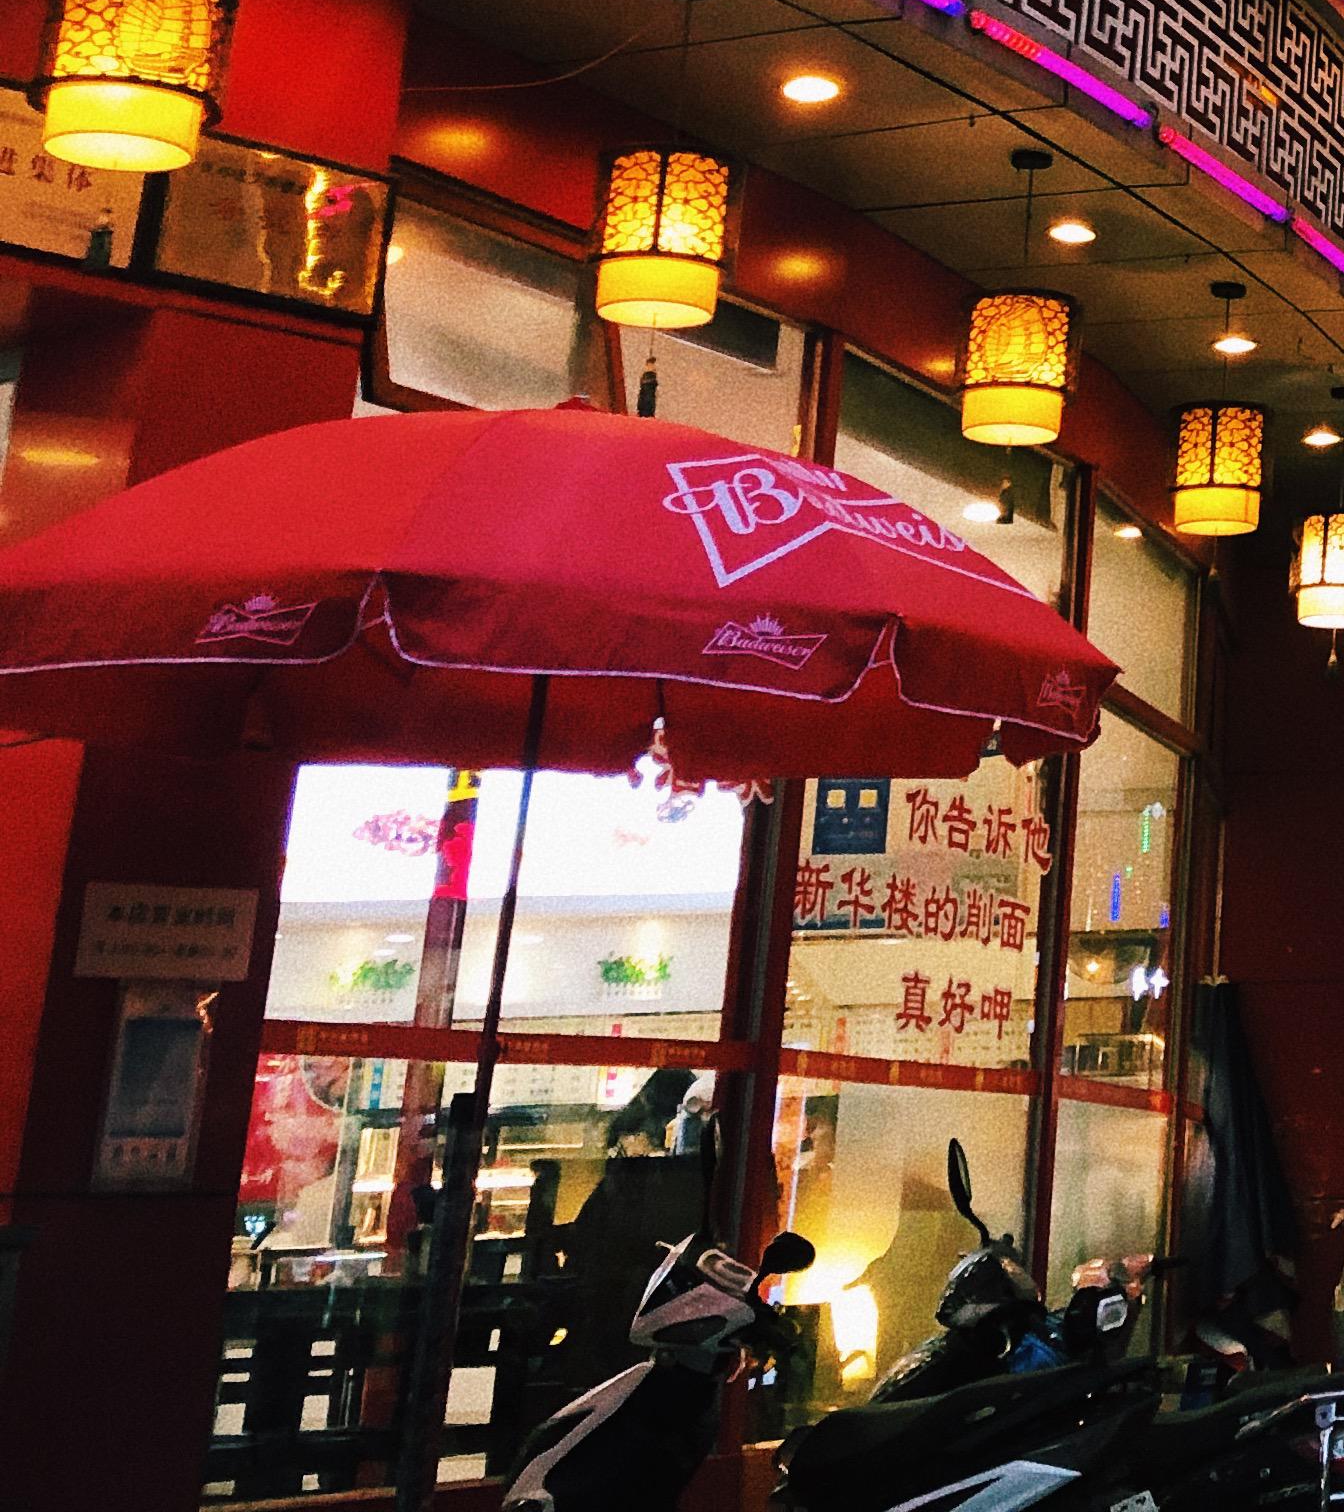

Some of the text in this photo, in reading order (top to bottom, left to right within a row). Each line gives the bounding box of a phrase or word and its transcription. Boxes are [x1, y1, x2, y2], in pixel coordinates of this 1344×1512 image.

[716, 628, 813, 657] Budweiser
[906, 786, 1051, 874] 你告诉他
[794, 858, 1031, 953] 新华楼的削面
[896, 970, 1012, 1040] 真好呷
